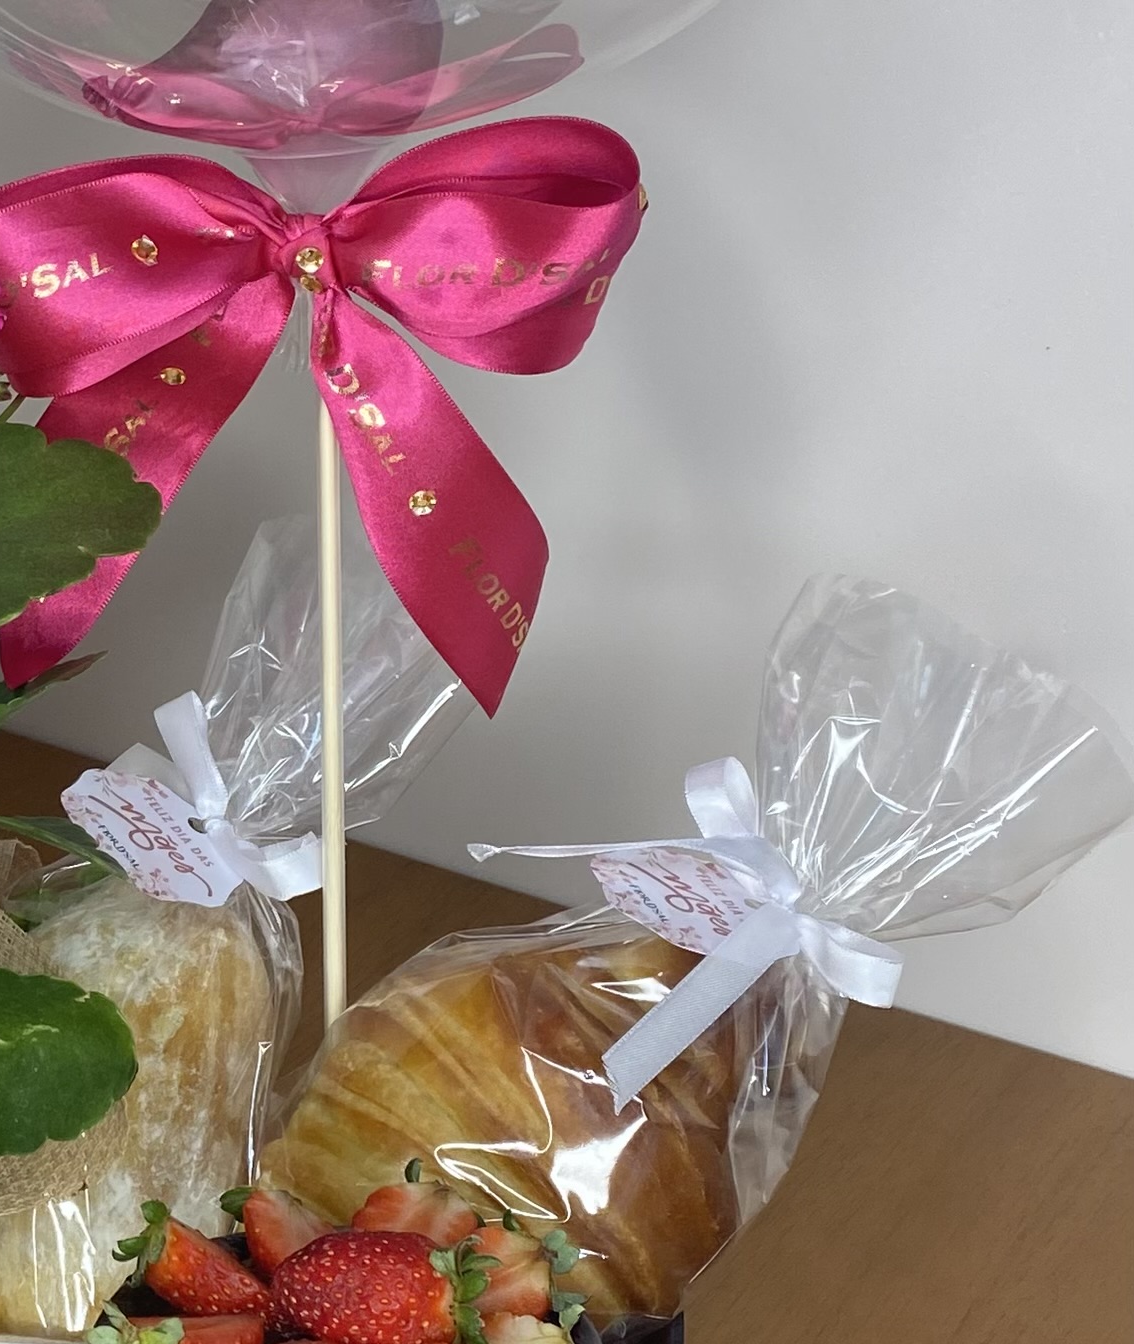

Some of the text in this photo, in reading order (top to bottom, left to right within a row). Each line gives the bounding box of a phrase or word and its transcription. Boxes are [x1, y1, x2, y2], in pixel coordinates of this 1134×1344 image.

[499, 601, 529, 653] D'S
[88, 789, 213, 897] mães
[144, 795, 215, 868] FELIZ DIA DAS
